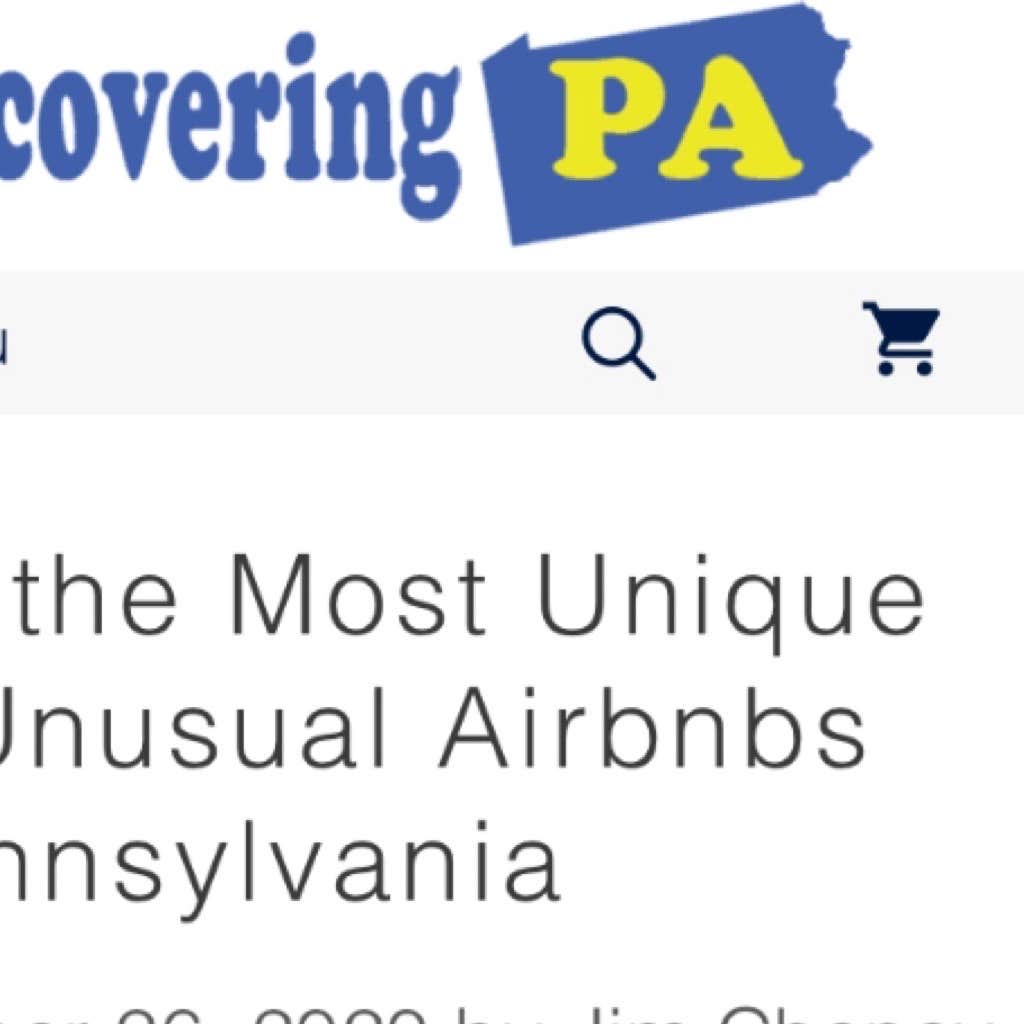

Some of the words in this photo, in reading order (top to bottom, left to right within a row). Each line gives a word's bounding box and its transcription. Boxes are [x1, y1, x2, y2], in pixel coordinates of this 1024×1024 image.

[549, 55, 805, 181] PA
[12, 553, 176, 636] the
[233, 553, 486, 636] Most
[540, 553, 923, 658] Unique
[438, 686, 864, 769] Airbnbs
